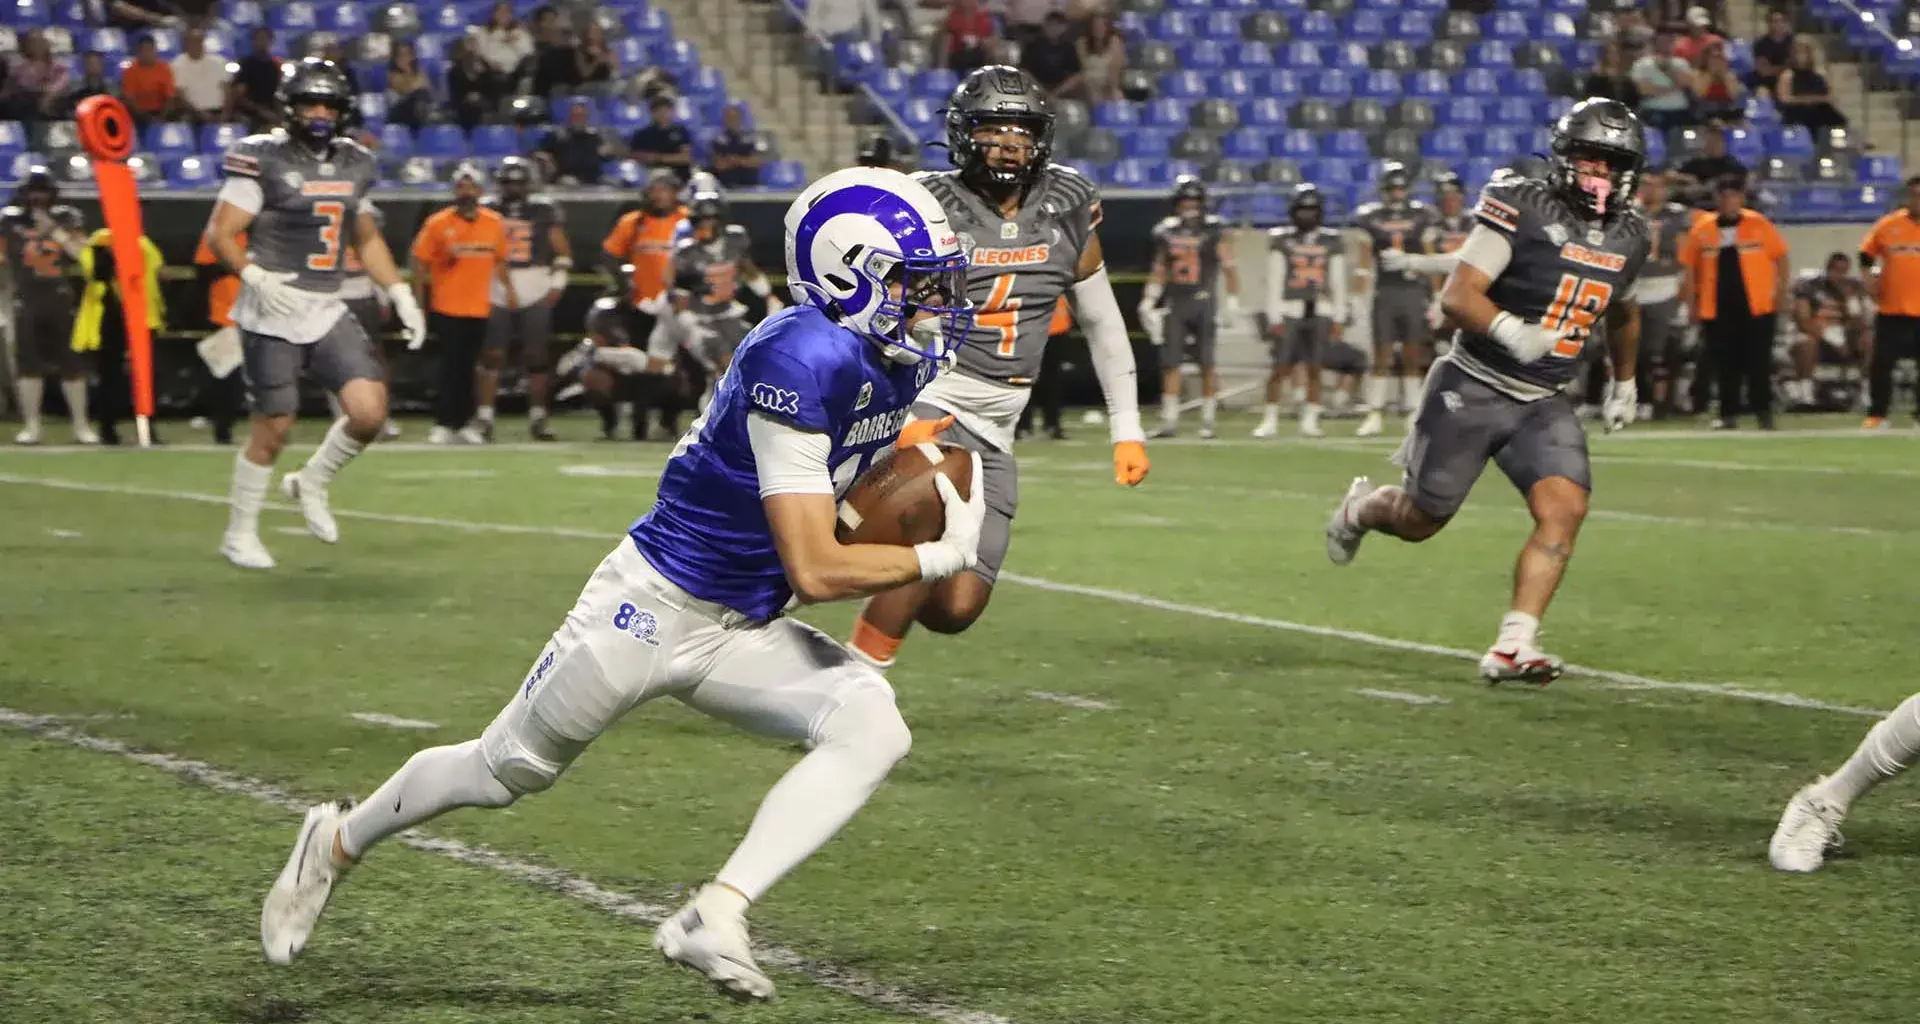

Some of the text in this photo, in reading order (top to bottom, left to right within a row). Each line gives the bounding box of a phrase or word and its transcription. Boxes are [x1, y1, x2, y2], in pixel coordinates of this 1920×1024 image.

[308, 201, 344, 270] 3
[972, 245, 1049, 265] LEONES
[974, 274, 1021, 357] 4
[1541, 272, 1613, 358] 18
